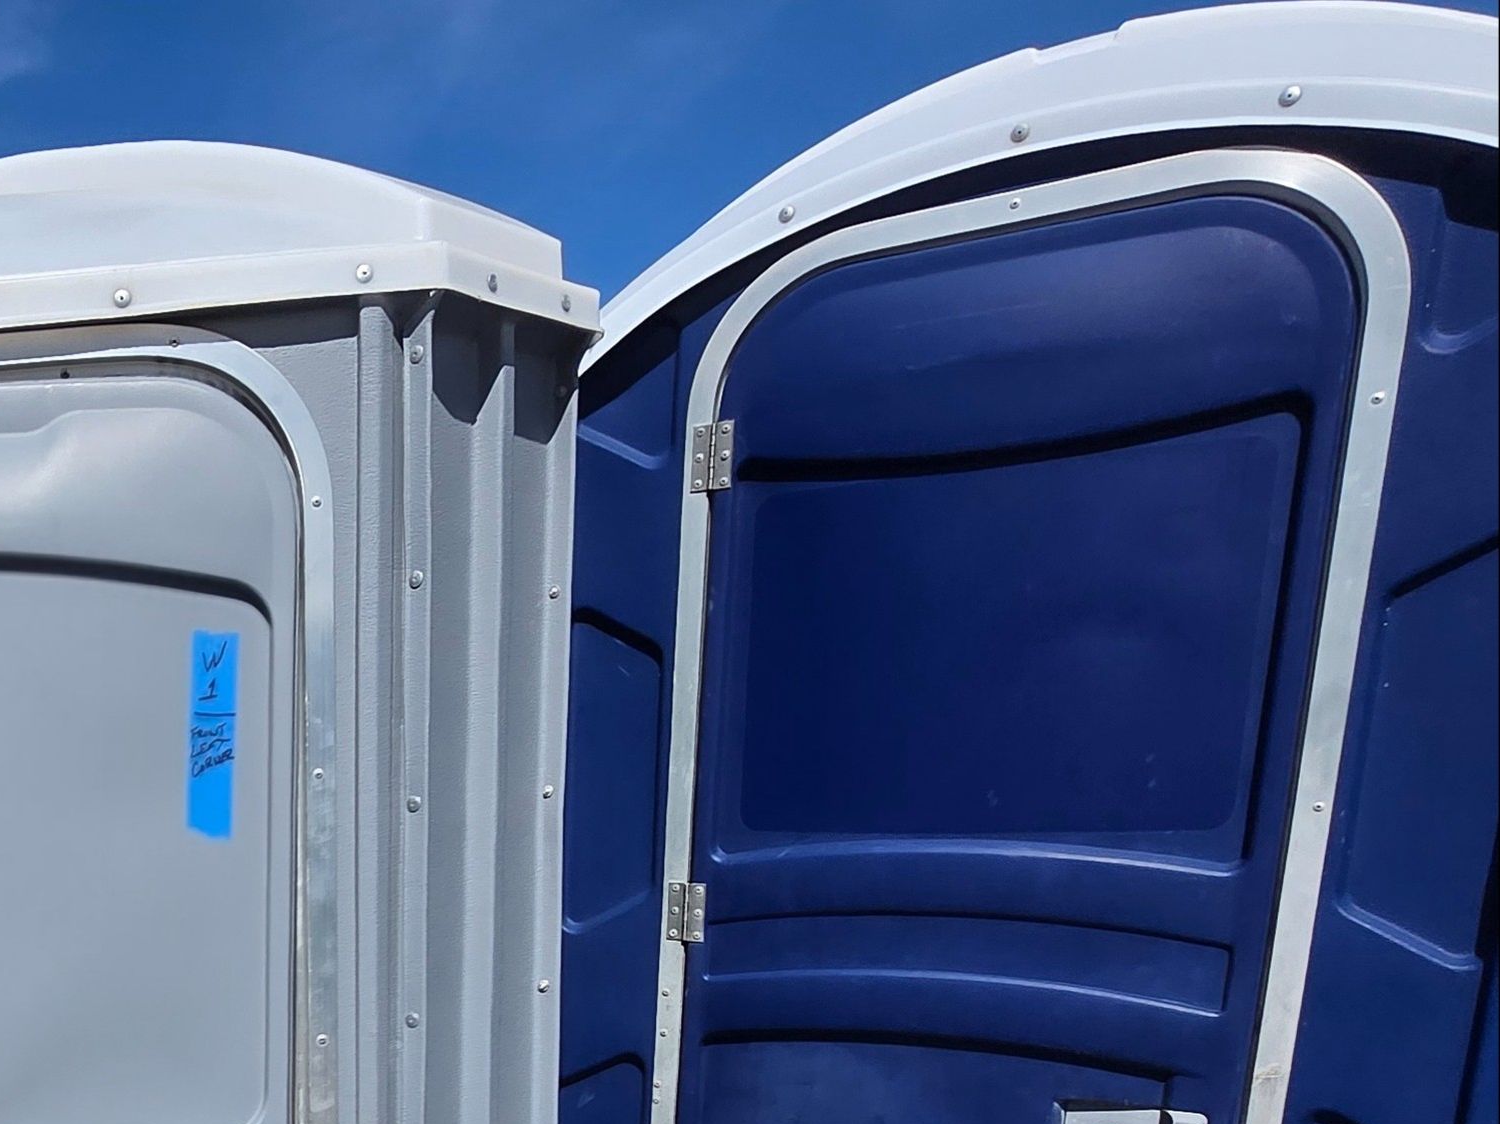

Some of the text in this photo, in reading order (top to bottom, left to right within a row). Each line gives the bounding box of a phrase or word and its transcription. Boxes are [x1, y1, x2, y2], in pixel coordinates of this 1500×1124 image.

[202, 640, 228, 672] W
[198, 677, 218, 701] 1
[190, 738, 231, 759] LEFT
[191, 748, 235, 778] CORNER
